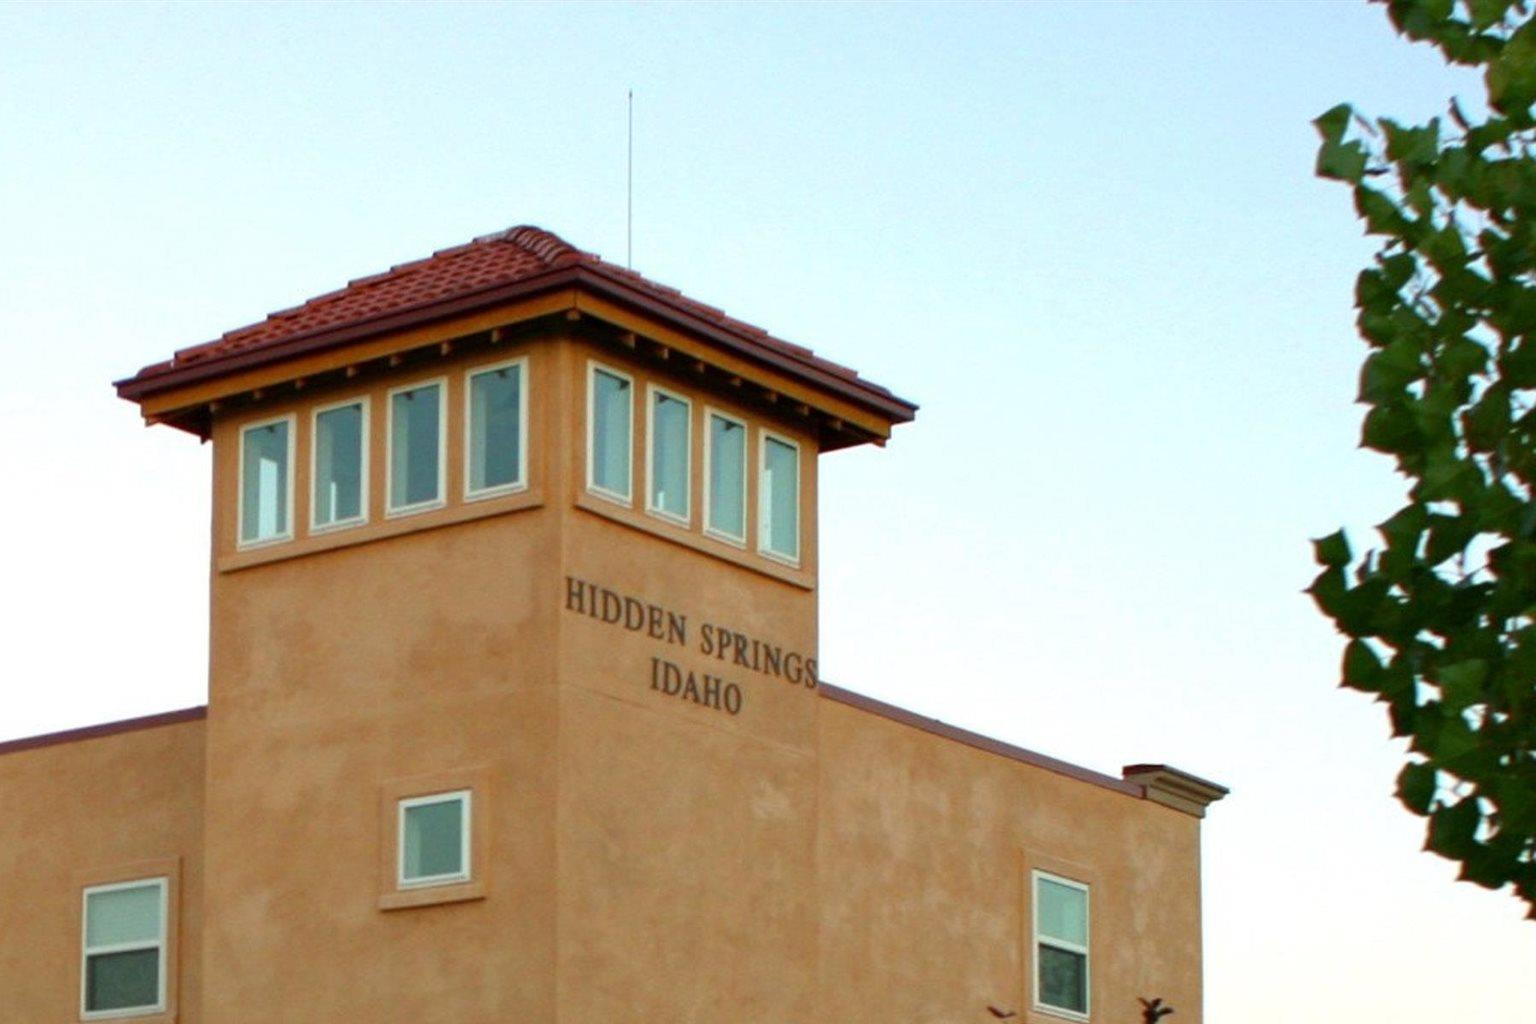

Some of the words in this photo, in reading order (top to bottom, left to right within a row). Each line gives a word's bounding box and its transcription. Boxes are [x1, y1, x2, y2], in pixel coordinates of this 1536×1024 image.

[565, 576, 687, 647] HIDDEN
[700, 622, 817, 689] SPRINGS
[650, 656, 743, 716] IDAHO
